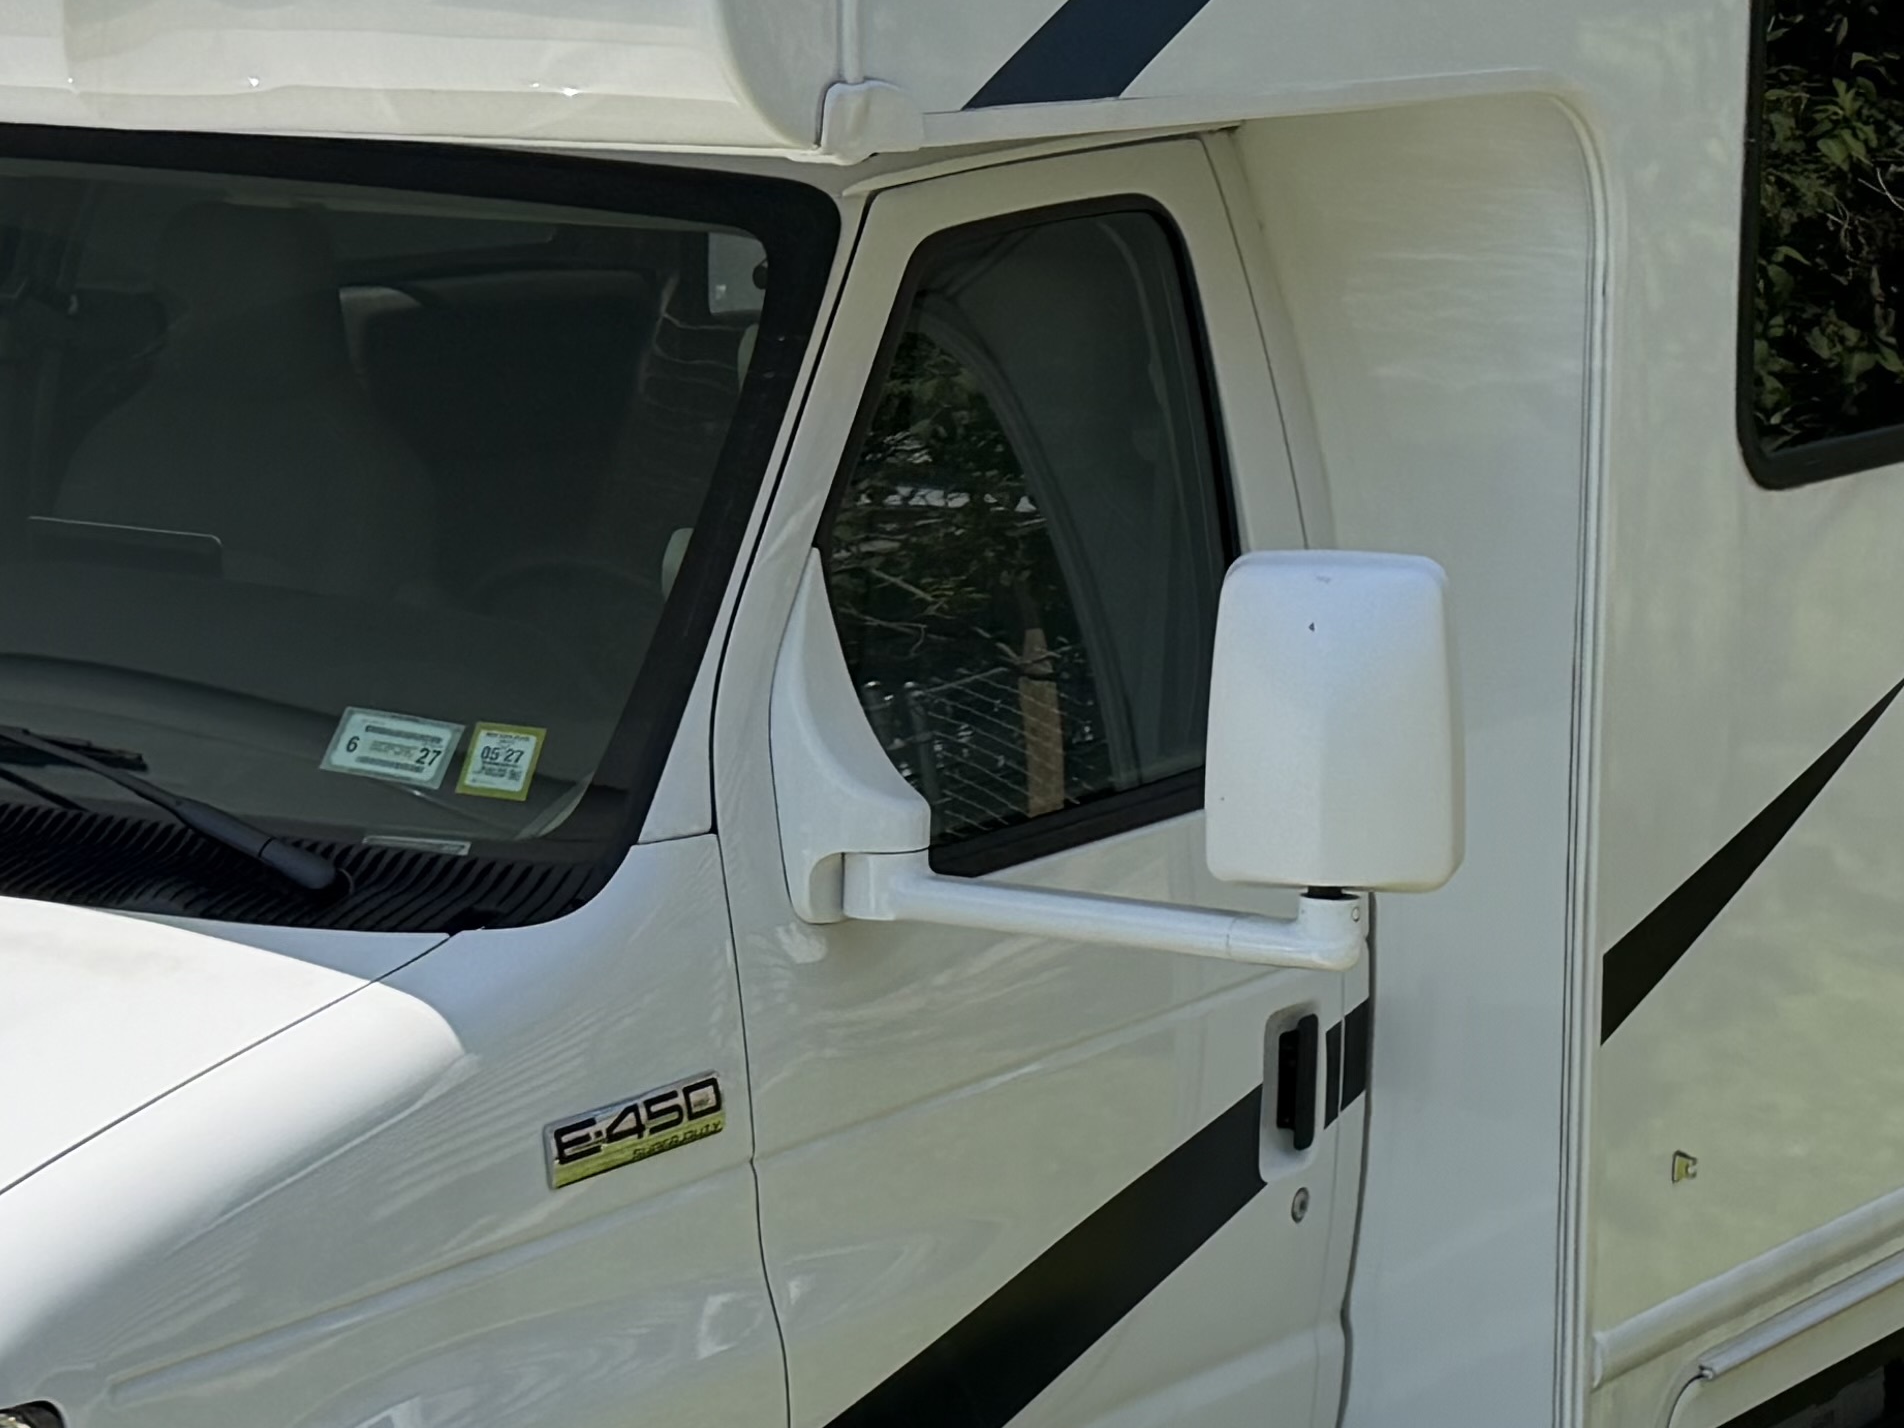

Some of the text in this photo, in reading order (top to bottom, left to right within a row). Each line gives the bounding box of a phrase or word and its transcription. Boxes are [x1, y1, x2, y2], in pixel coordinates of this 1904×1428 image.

[346, 736, 360, 753] 6
[415, 747, 442, 767] 27
[480, 745, 525, 764] 05 27
[553, 1076, 723, 1166] E-450
